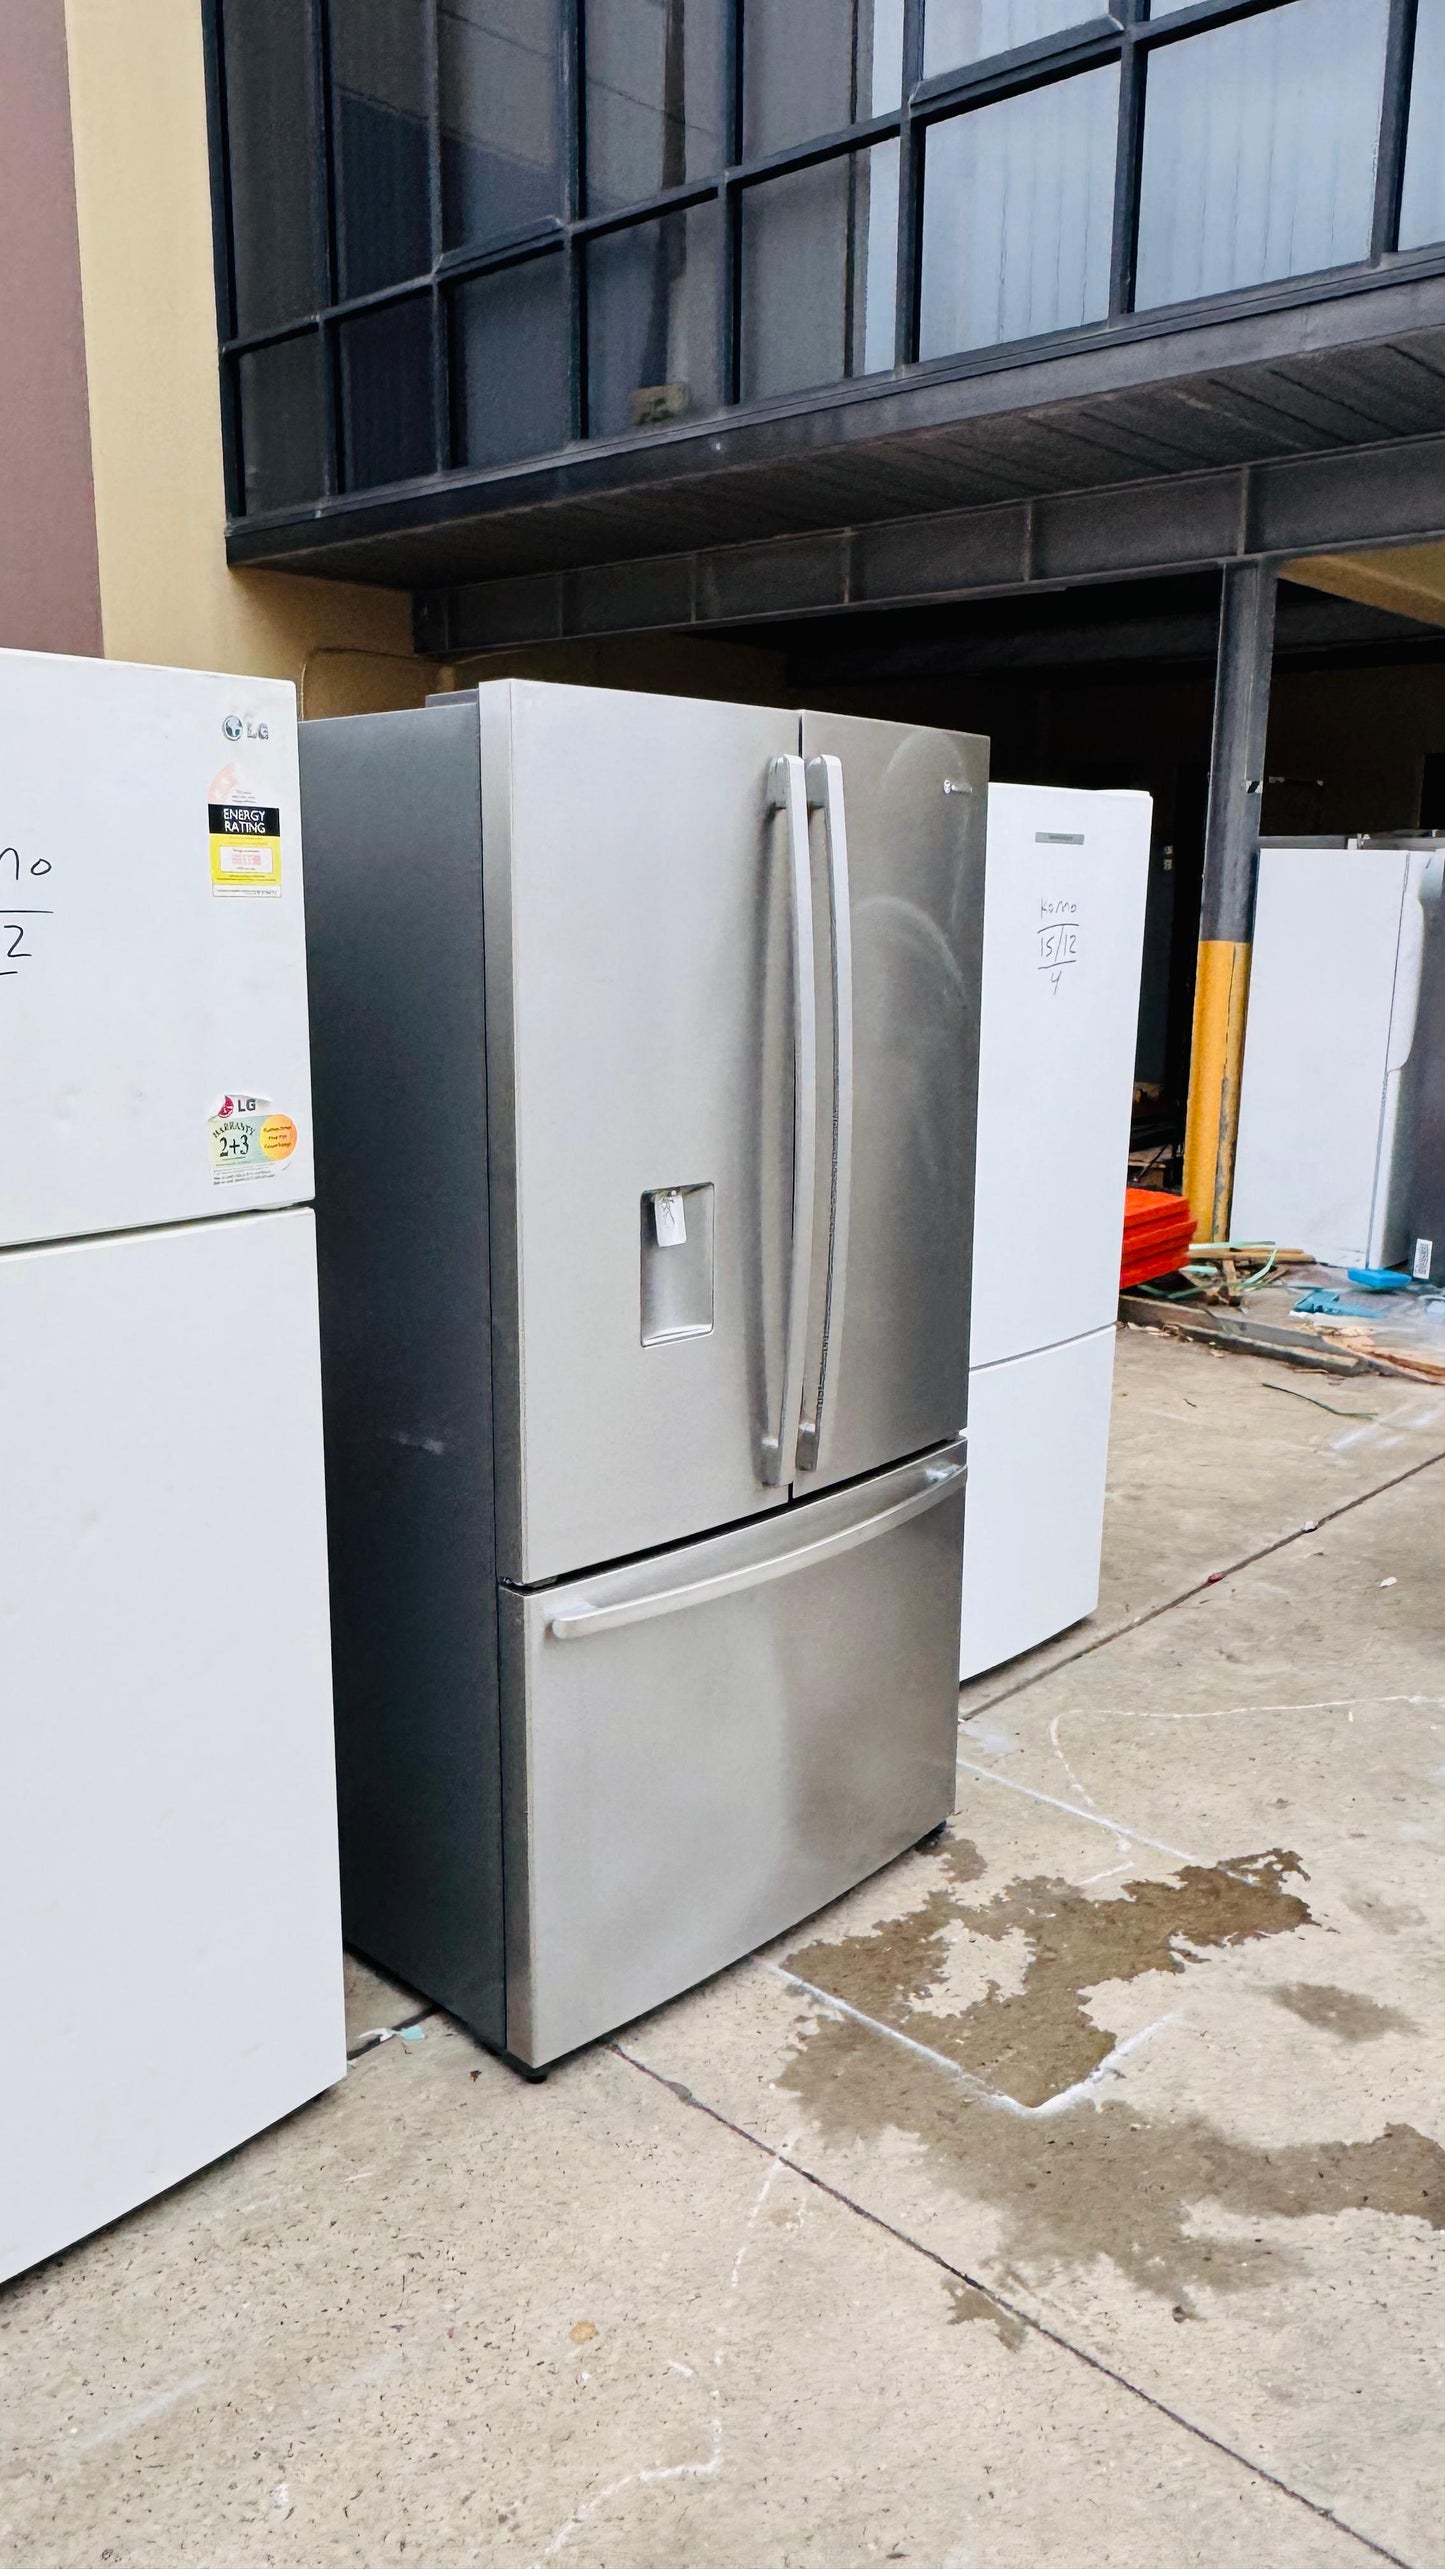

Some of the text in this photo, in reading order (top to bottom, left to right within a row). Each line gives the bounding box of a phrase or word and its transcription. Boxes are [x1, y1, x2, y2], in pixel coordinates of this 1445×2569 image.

[247, 721, 269, 740] LG
[223, 808, 265, 822] ENERGY
[224, 821, 266, 834] RATING
[1040, 926, 1077, 962] 15/12
[238, 1099, 256, 1112] LG
[219, 1134, 249, 1157] 2+3
